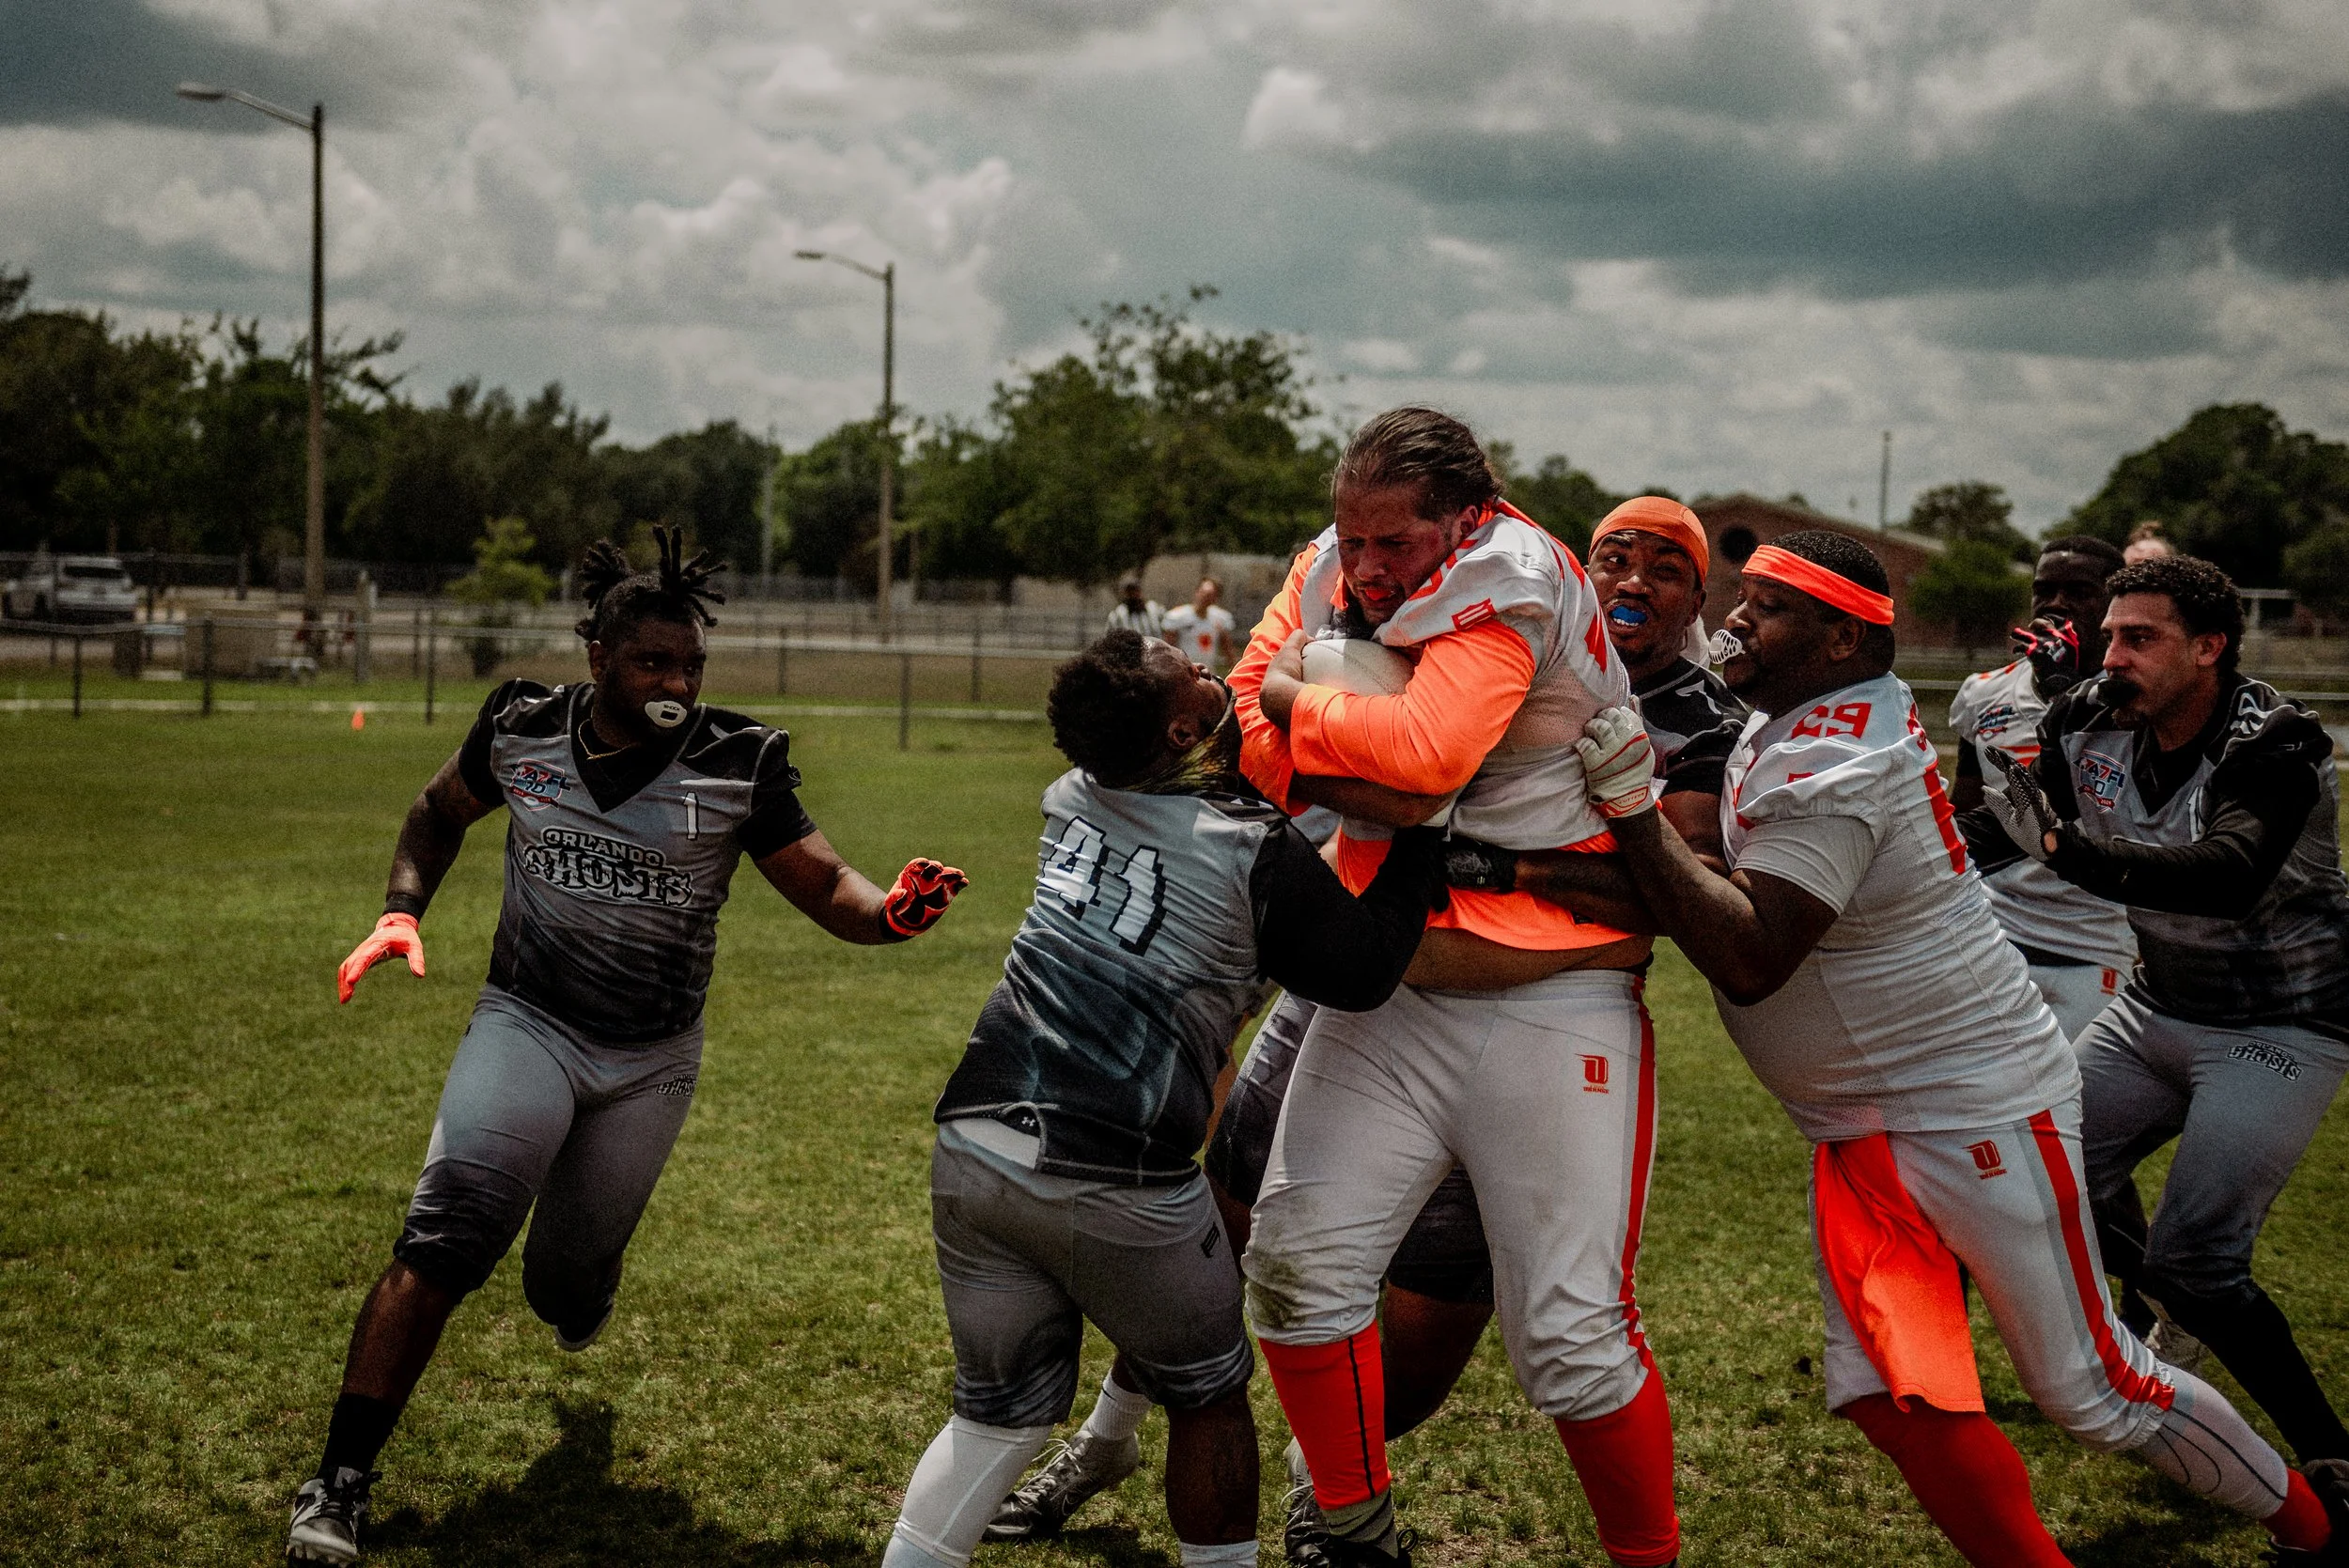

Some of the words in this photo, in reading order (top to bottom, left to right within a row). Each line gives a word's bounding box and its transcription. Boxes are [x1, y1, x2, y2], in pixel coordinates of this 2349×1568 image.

[683, 791, 700, 841] 1
[544, 828, 663, 867] ORLANDO
[523, 845, 695, 907] GHOSTS
